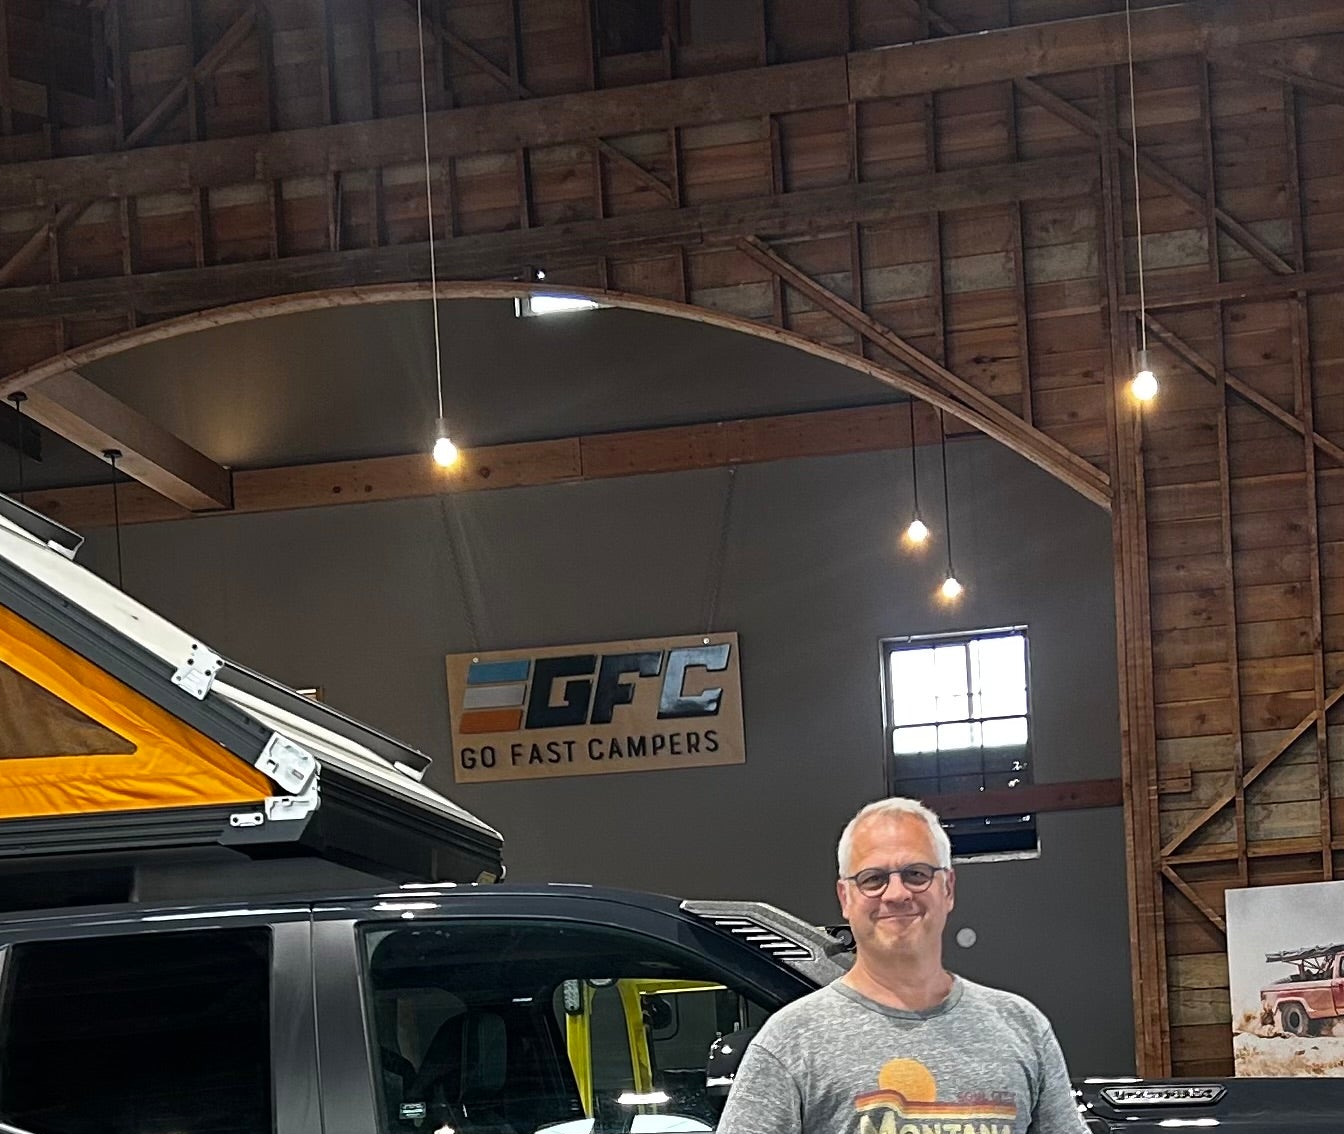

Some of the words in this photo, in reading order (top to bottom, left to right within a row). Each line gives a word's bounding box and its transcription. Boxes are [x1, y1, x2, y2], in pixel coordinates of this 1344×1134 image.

[524, 643, 731, 730] GFC
[461, 745, 496, 770] GO
[511, 739, 575, 766] FAST
[588, 730, 720, 761] CAMPERS
